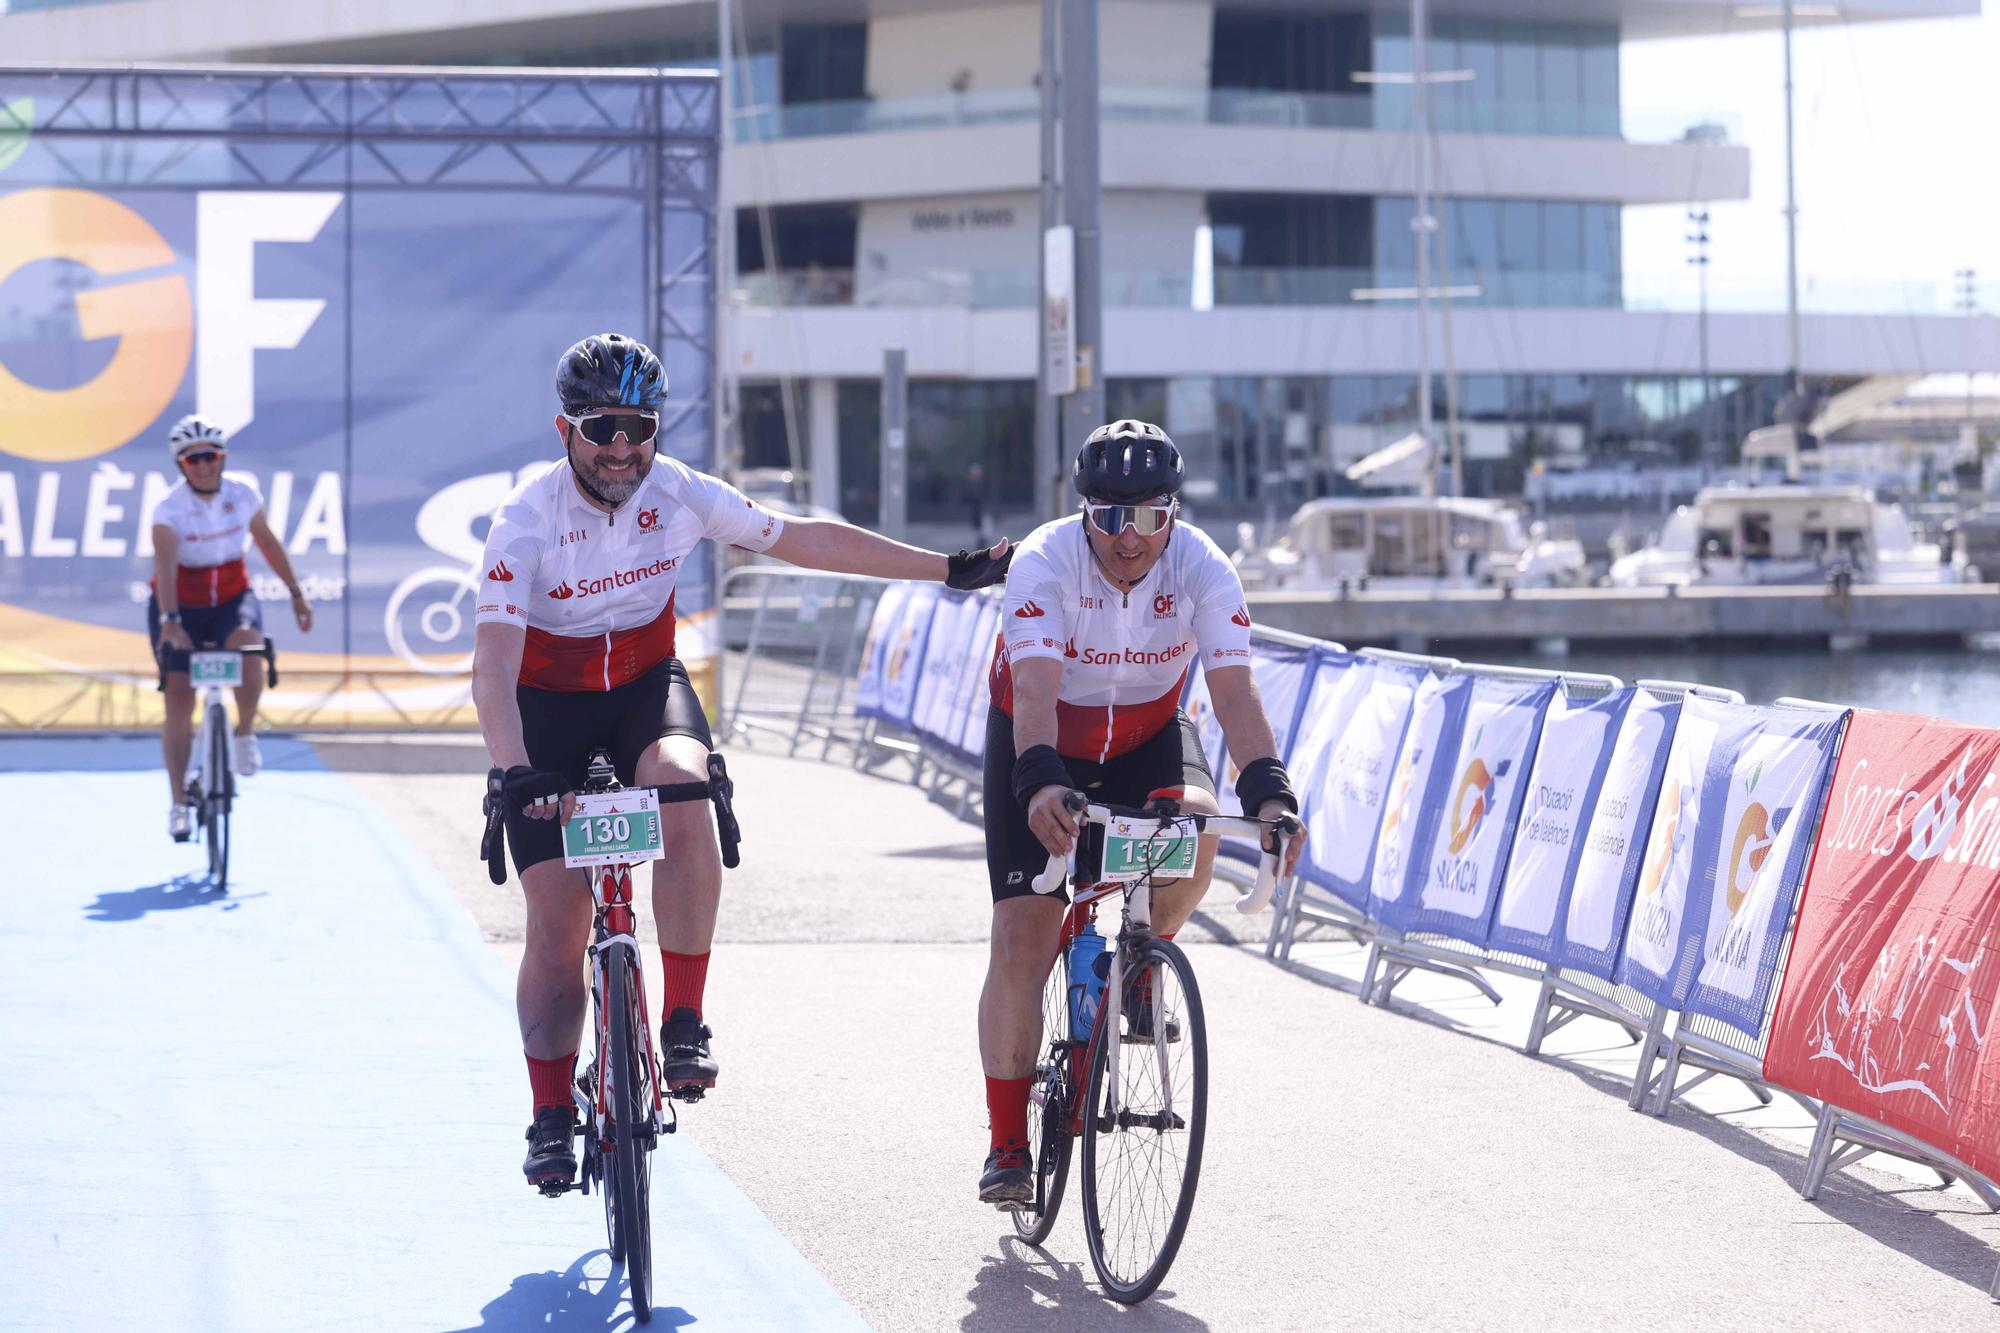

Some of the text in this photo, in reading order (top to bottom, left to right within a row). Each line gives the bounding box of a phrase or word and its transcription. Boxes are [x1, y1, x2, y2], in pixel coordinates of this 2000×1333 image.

[577, 556, 681, 598] Santander
[1081, 641, 1188, 665] Santander
[580, 816, 631, 844] 130
[1825, 758, 1921, 874] Sports
[647, 816, 657, 845] 76 km
[1121, 840, 1171, 864] 137
[1182, 842, 1193, 866] 76 km
